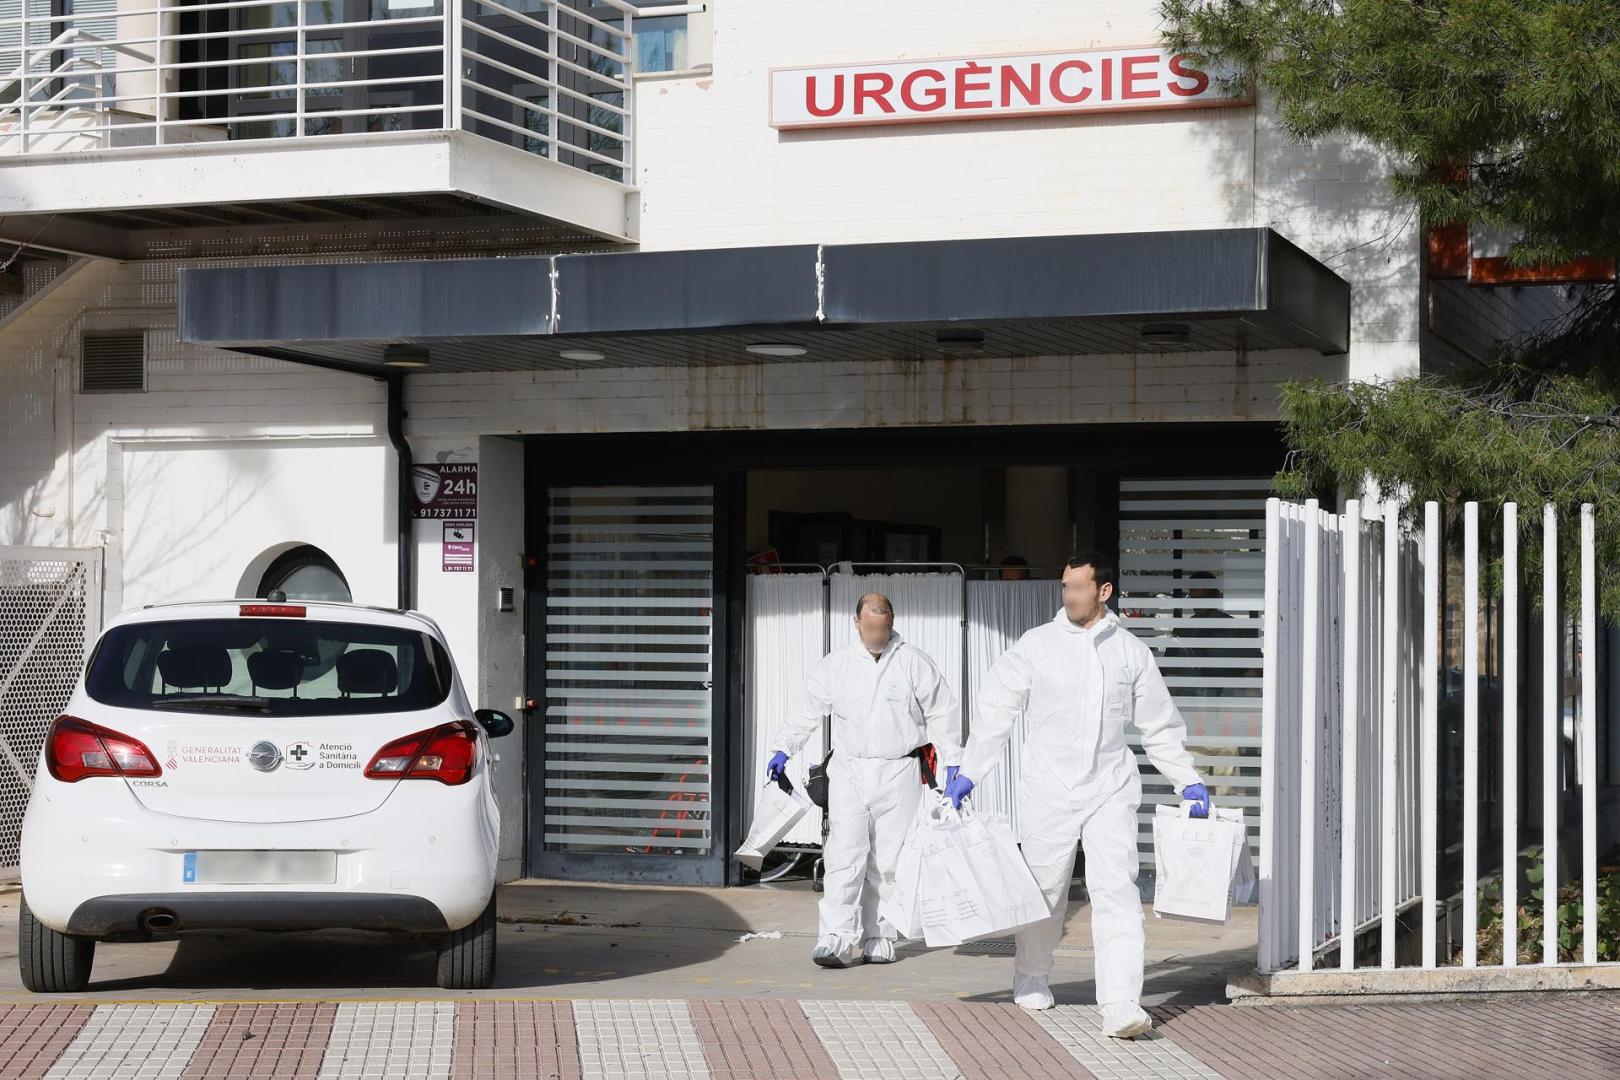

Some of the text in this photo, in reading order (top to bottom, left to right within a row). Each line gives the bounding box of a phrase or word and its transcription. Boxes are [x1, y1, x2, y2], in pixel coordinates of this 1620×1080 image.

[805, 52, 1209, 118] URGÈNCIES
[443, 479, 476, 495] 24h
[420, 508, 476, 517] 91 737 11 71
[182, 746, 242, 754] GENERALITAT
[319, 743, 353, 751] Atenció
[326, 761, 361, 769] Domicili
[132, 780, 169, 788] CORSA
